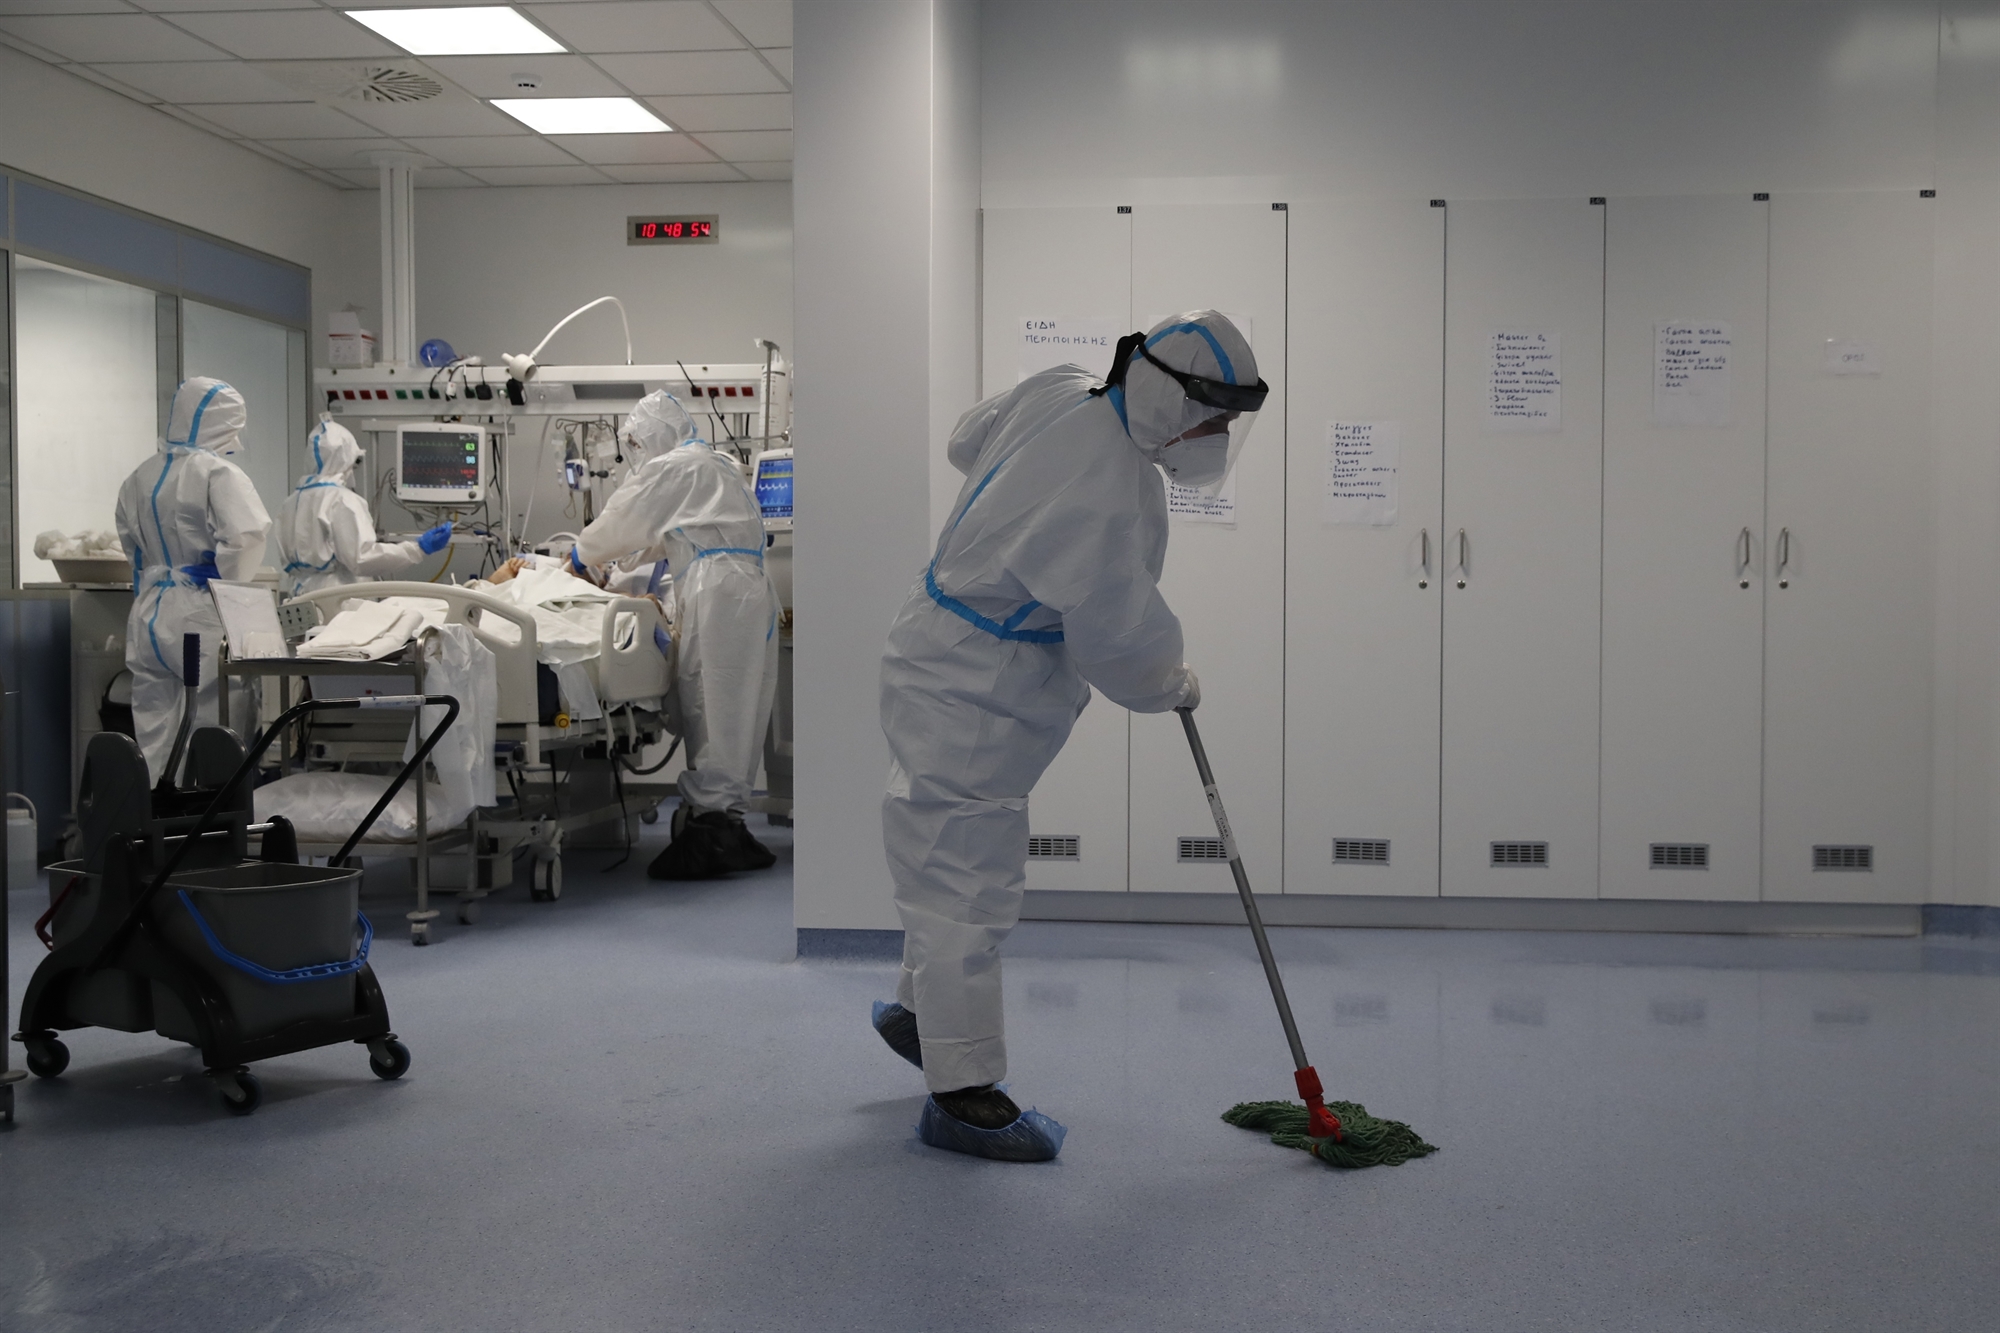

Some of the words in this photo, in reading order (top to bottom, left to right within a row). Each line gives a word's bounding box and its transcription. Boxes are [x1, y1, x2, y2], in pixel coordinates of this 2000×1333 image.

[641, 222, 656, 238] 10
[664, 221, 682, 238] 48
[691, 221, 710, 238] 54
[1026, 321, 1056, 330] ΕΙΔΗ
